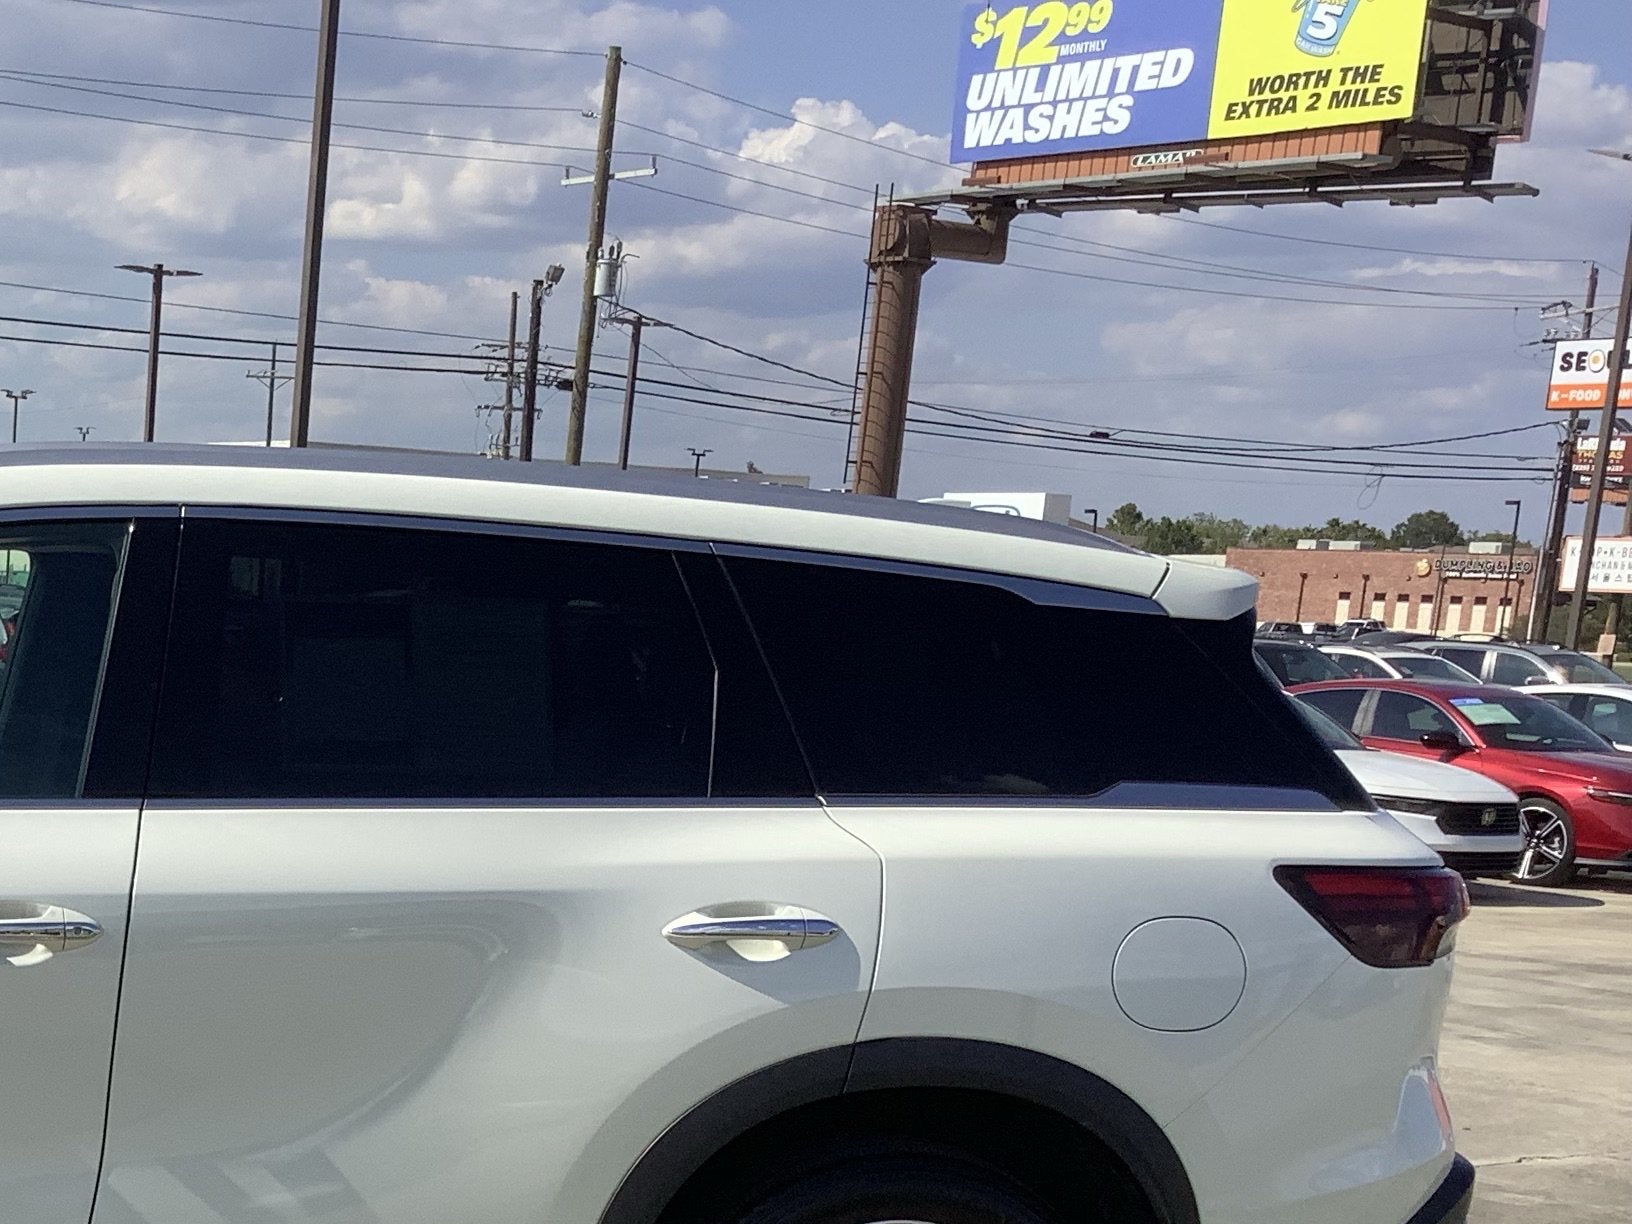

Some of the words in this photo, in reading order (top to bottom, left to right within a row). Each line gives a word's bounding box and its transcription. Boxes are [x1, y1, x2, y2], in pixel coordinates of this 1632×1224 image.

[1306, 4, 1345, 40] 5
[1060, 39, 1107, 57] MONTHLY
[966, 48, 1195, 111] UNLIMITED
[1248, 69, 1331, 97] WORTH
[1339, 64, 1384, 86] THE
[1224, 97, 1297, 121] EXTRA
[1305, 92, 1320, 112] 2
[1328, 85, 1404, 110] MILES
[963, 94, 1135, 149] WASHES
[1551, 389, 1601, 402] K-FOOD
[1434, 559, 1494, 572] DUMPLING
